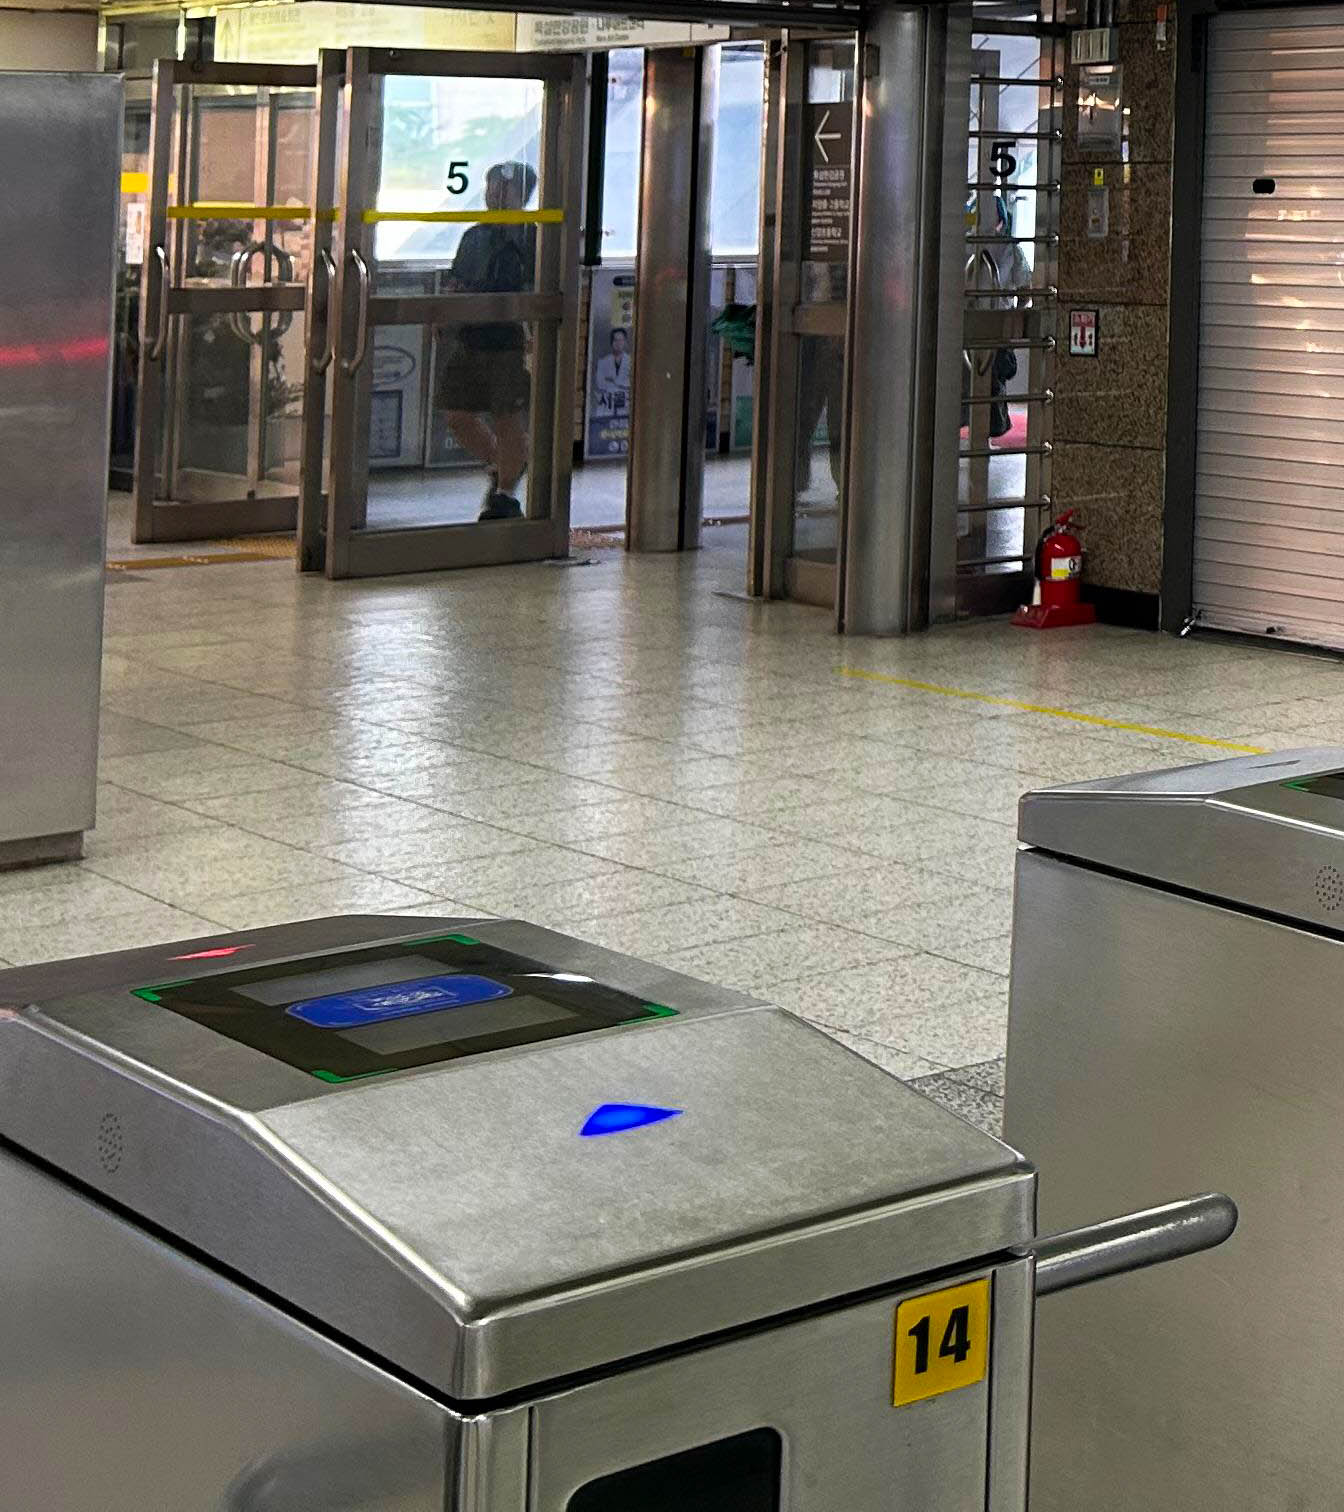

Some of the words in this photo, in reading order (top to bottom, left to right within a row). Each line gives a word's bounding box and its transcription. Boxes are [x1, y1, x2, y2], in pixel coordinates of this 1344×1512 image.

[446, 161, 470, 194] 5
[989, 141, 1017, 178] 5
[908, 1304, 971, 1375] 14
